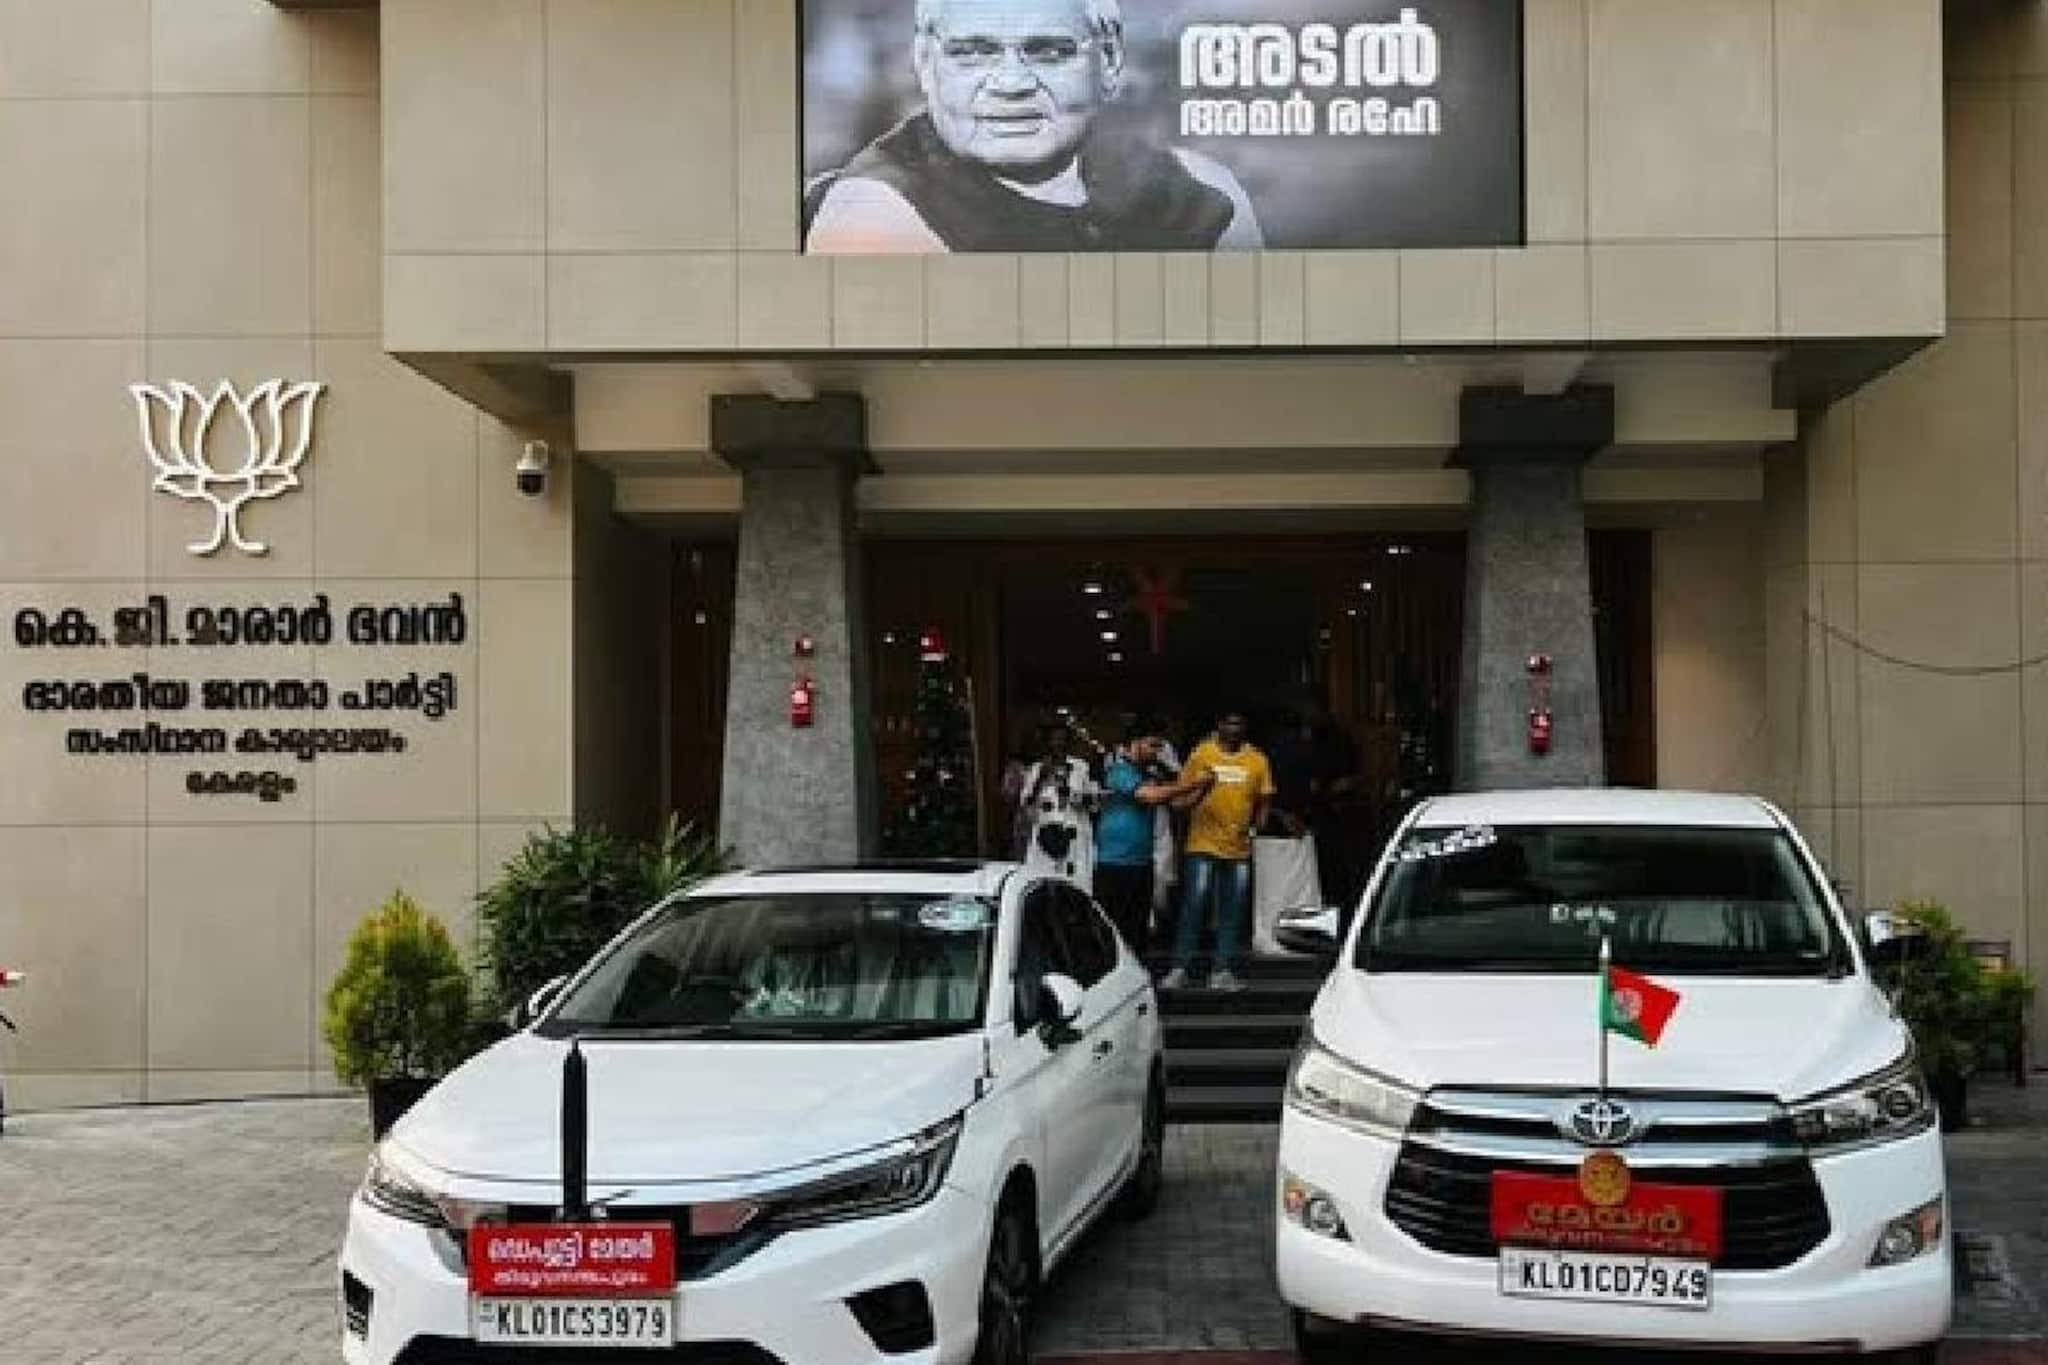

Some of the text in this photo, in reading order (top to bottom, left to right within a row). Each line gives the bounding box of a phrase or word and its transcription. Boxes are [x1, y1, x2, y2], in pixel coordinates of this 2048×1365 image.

[1180, 8, 1438, 87] അടൽ
[1180, 89, 1440, 136] അമർ രഹേ
[347, 592, 466, 646] ഭവൻ
[23, 672, 458, 719] ഭാരതീയ ജനതാ പാർട്ടി
[1523, 1261, 1708, 1301] KL01CD7949
[498, 1304, 666, 1338] KL01CS3979
